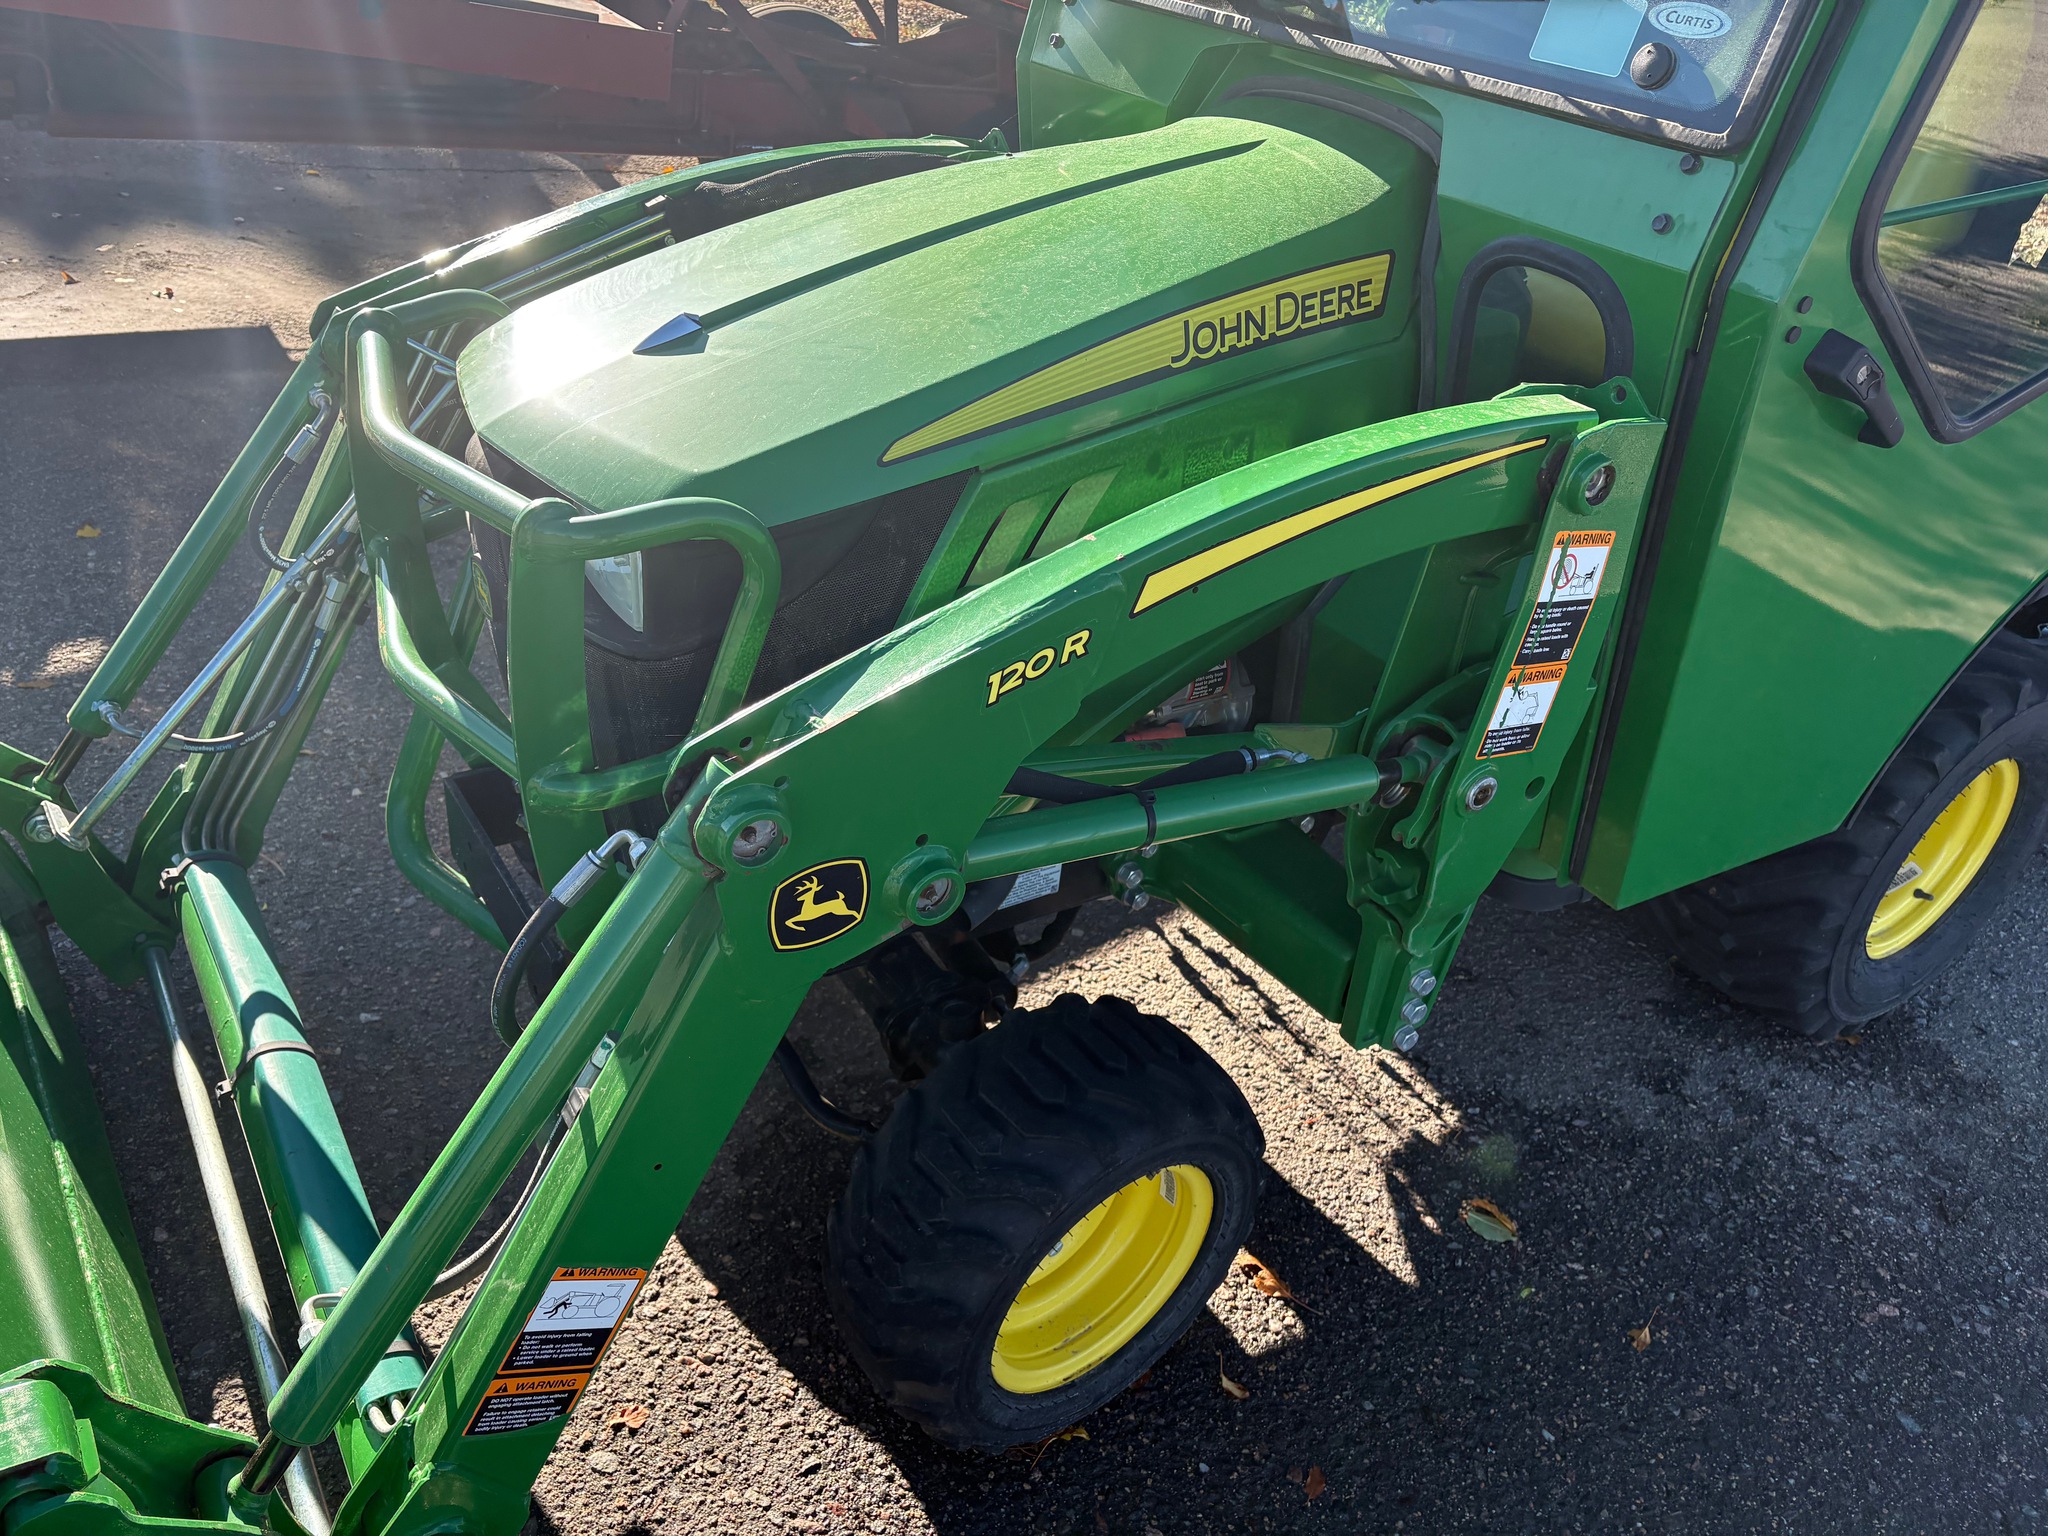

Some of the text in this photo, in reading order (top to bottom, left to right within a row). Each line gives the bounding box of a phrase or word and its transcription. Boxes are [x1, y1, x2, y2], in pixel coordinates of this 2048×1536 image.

[1666, 10, 1714, 29] CURTIS
[1170, 279, 1373, 365] JOHN DEERE
[1568, 532, 1612, 545] WARNING
[986, 629, 1092, 707] 120 R
[1520, 668, 1562, 684] WARNING
[578, 1268, 638, 1277] WARNING
[515, 1379, 577, 1392] WARNING
